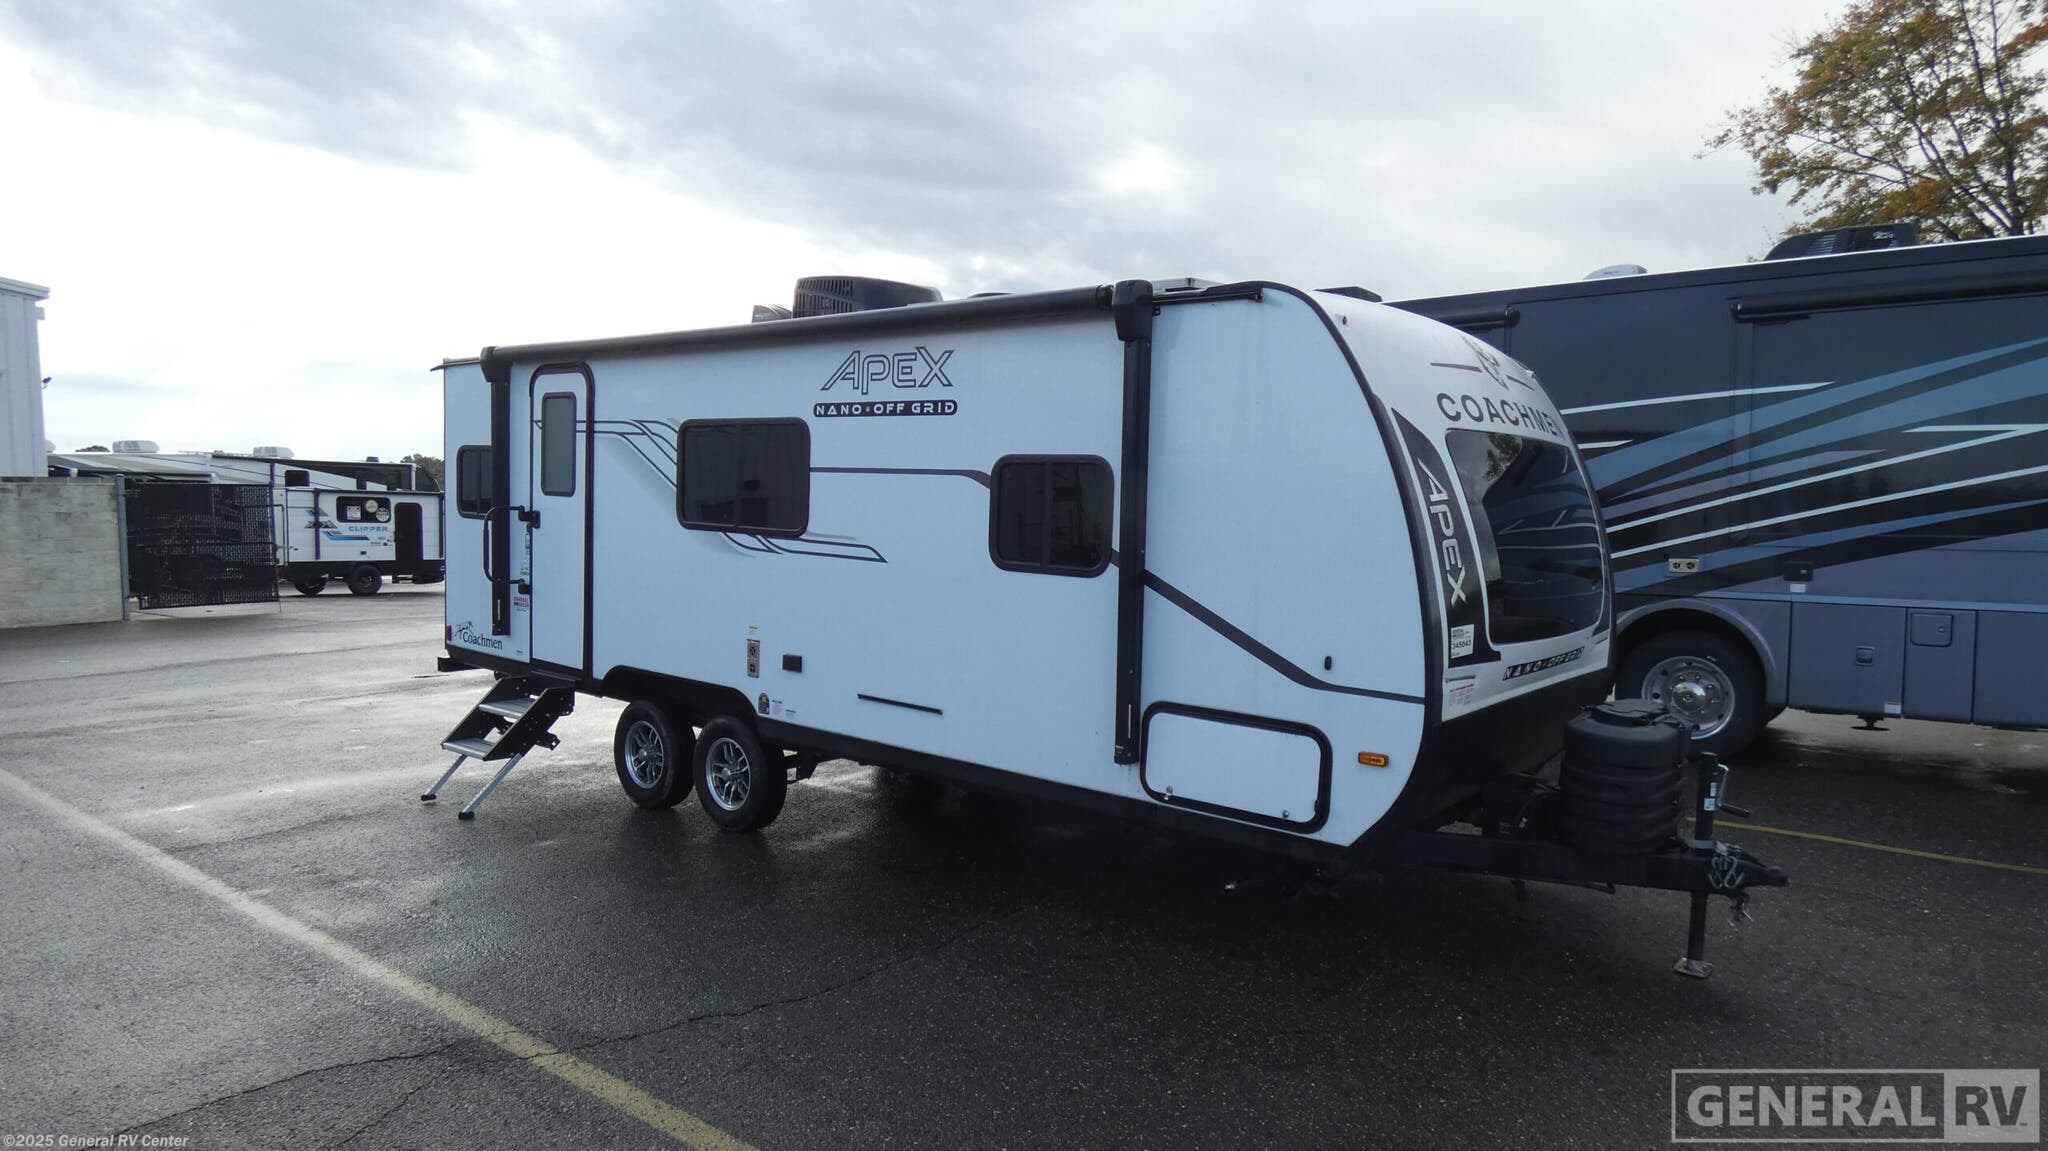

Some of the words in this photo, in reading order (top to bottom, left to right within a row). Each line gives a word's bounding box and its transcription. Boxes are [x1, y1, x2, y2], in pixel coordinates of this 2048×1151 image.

[820, 346, 955, 395] APEX
[816, 404, 862, 415] NANO
[873, 403, 905, 414] OFF
[911, 402, 955, 413] GRID
[1416, 457, 1467, 608] APEX
[462, 631, 503, 650] Coachmen
[1503, 661, 1541, 679] NANO
